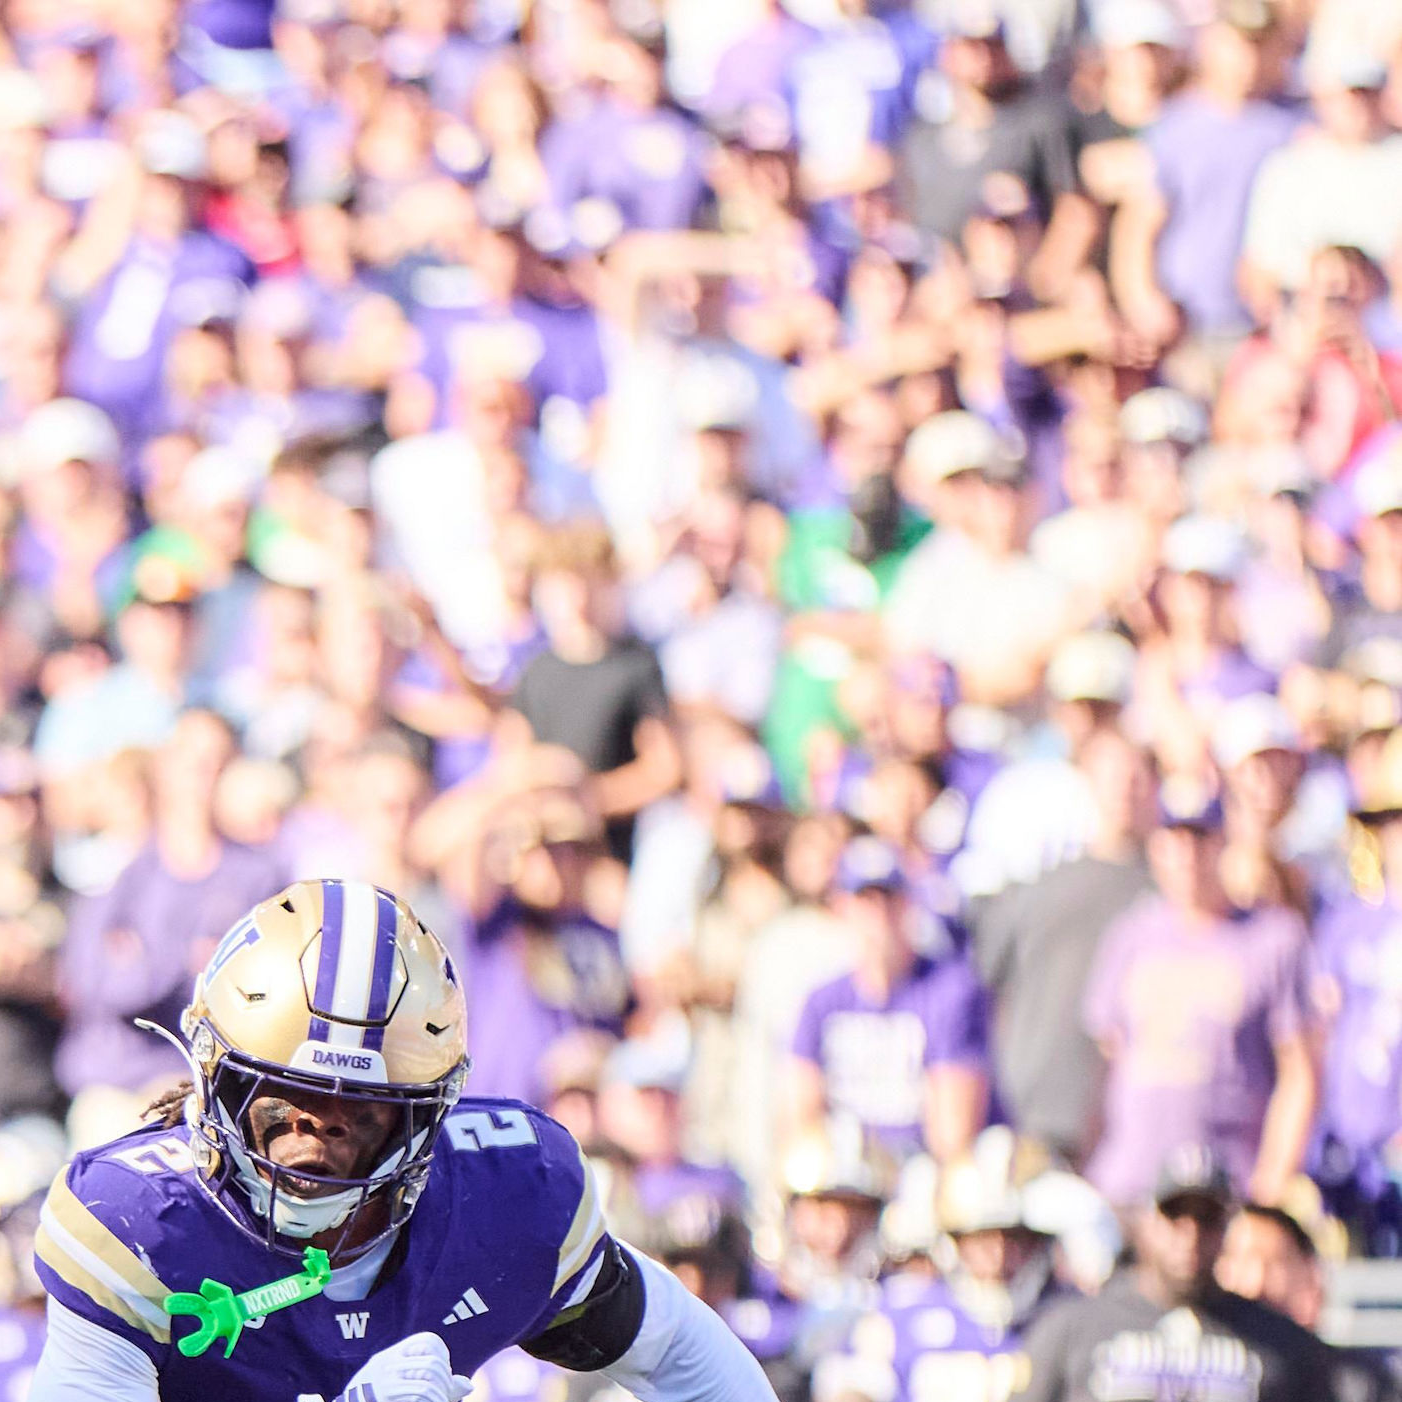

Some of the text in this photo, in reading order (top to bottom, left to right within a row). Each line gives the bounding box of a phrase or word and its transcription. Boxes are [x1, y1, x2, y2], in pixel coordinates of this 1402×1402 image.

[312, 1049, 372, 1070] DAWGS
[442, 1109, 538, 1151] 2
[111, 1136, 196, 1176] 2
[243, 1279, 302, 1315] NXTRND
[335, 1311, 371, 1340] W
